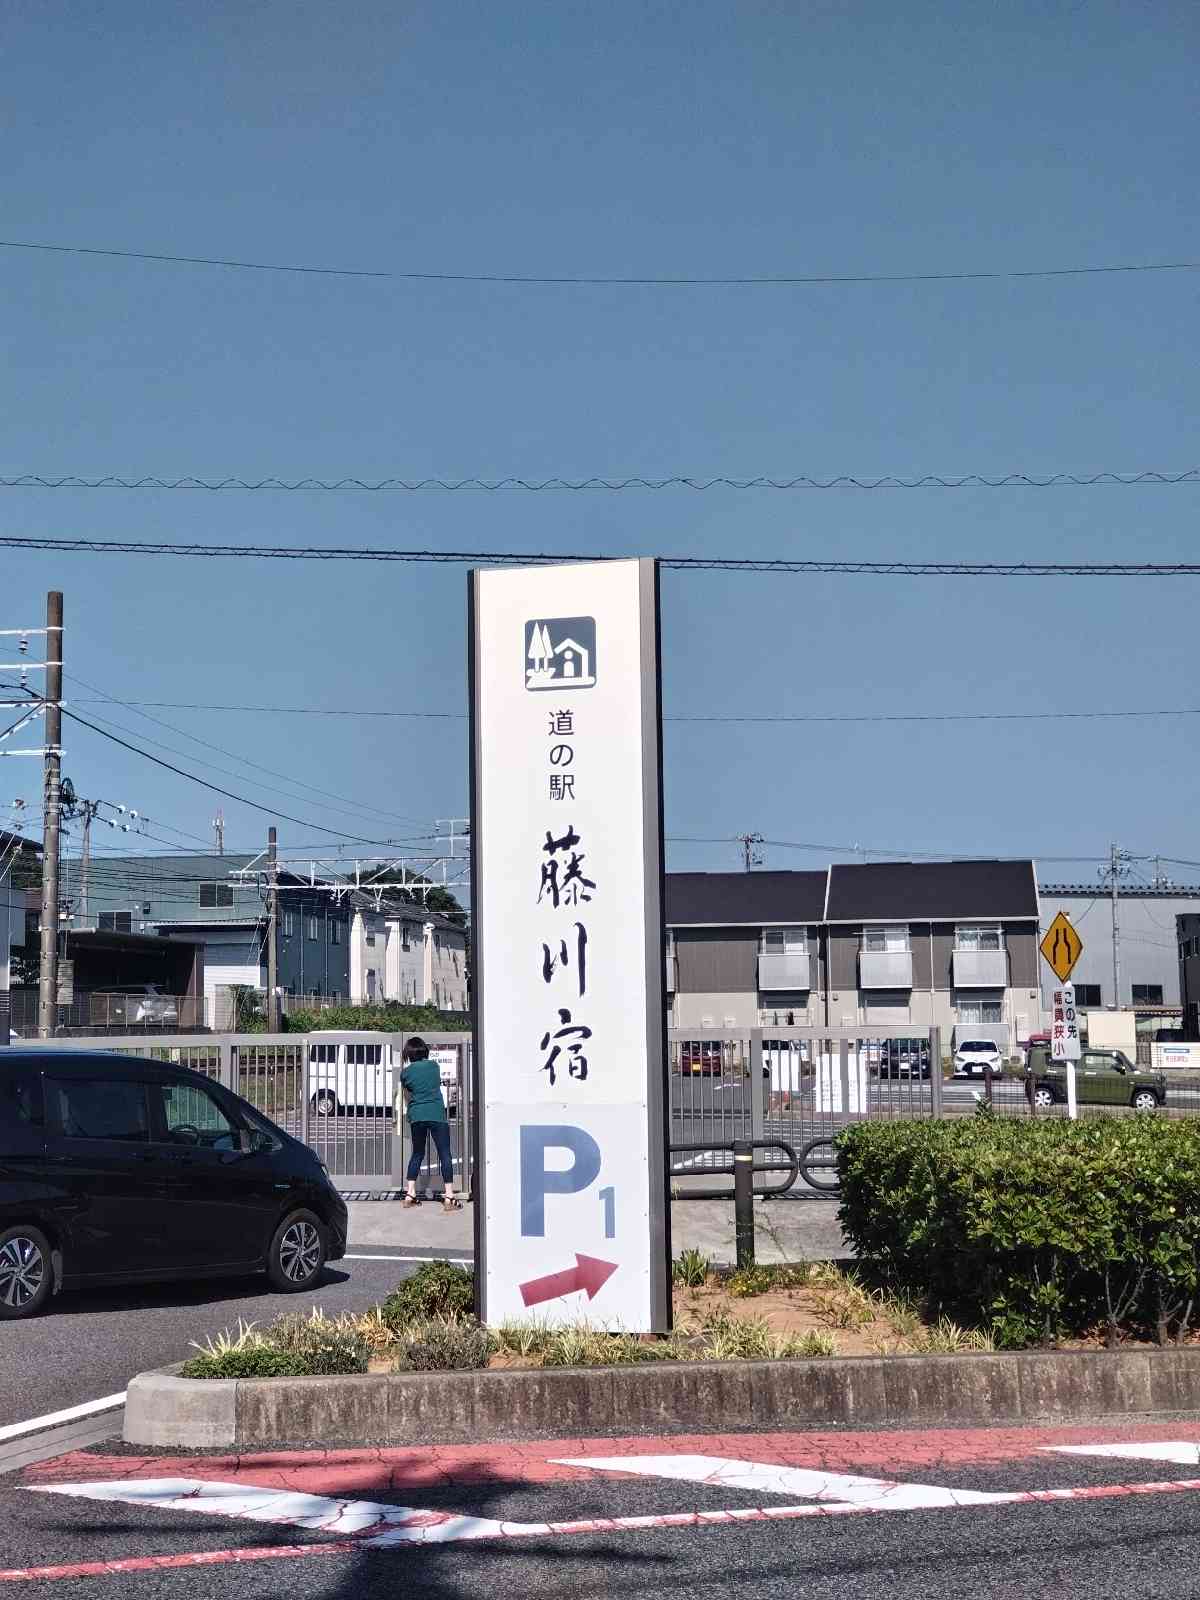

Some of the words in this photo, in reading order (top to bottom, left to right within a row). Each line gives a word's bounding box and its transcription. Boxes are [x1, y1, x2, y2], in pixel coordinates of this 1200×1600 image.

[548, 710, 576, 801] 道の駅
[536, 825, 598, 1087] 藤川宿
[1054, 991, 1065, 1057] 幅員狭小
[1064, 991, 1077, 1039] この先
